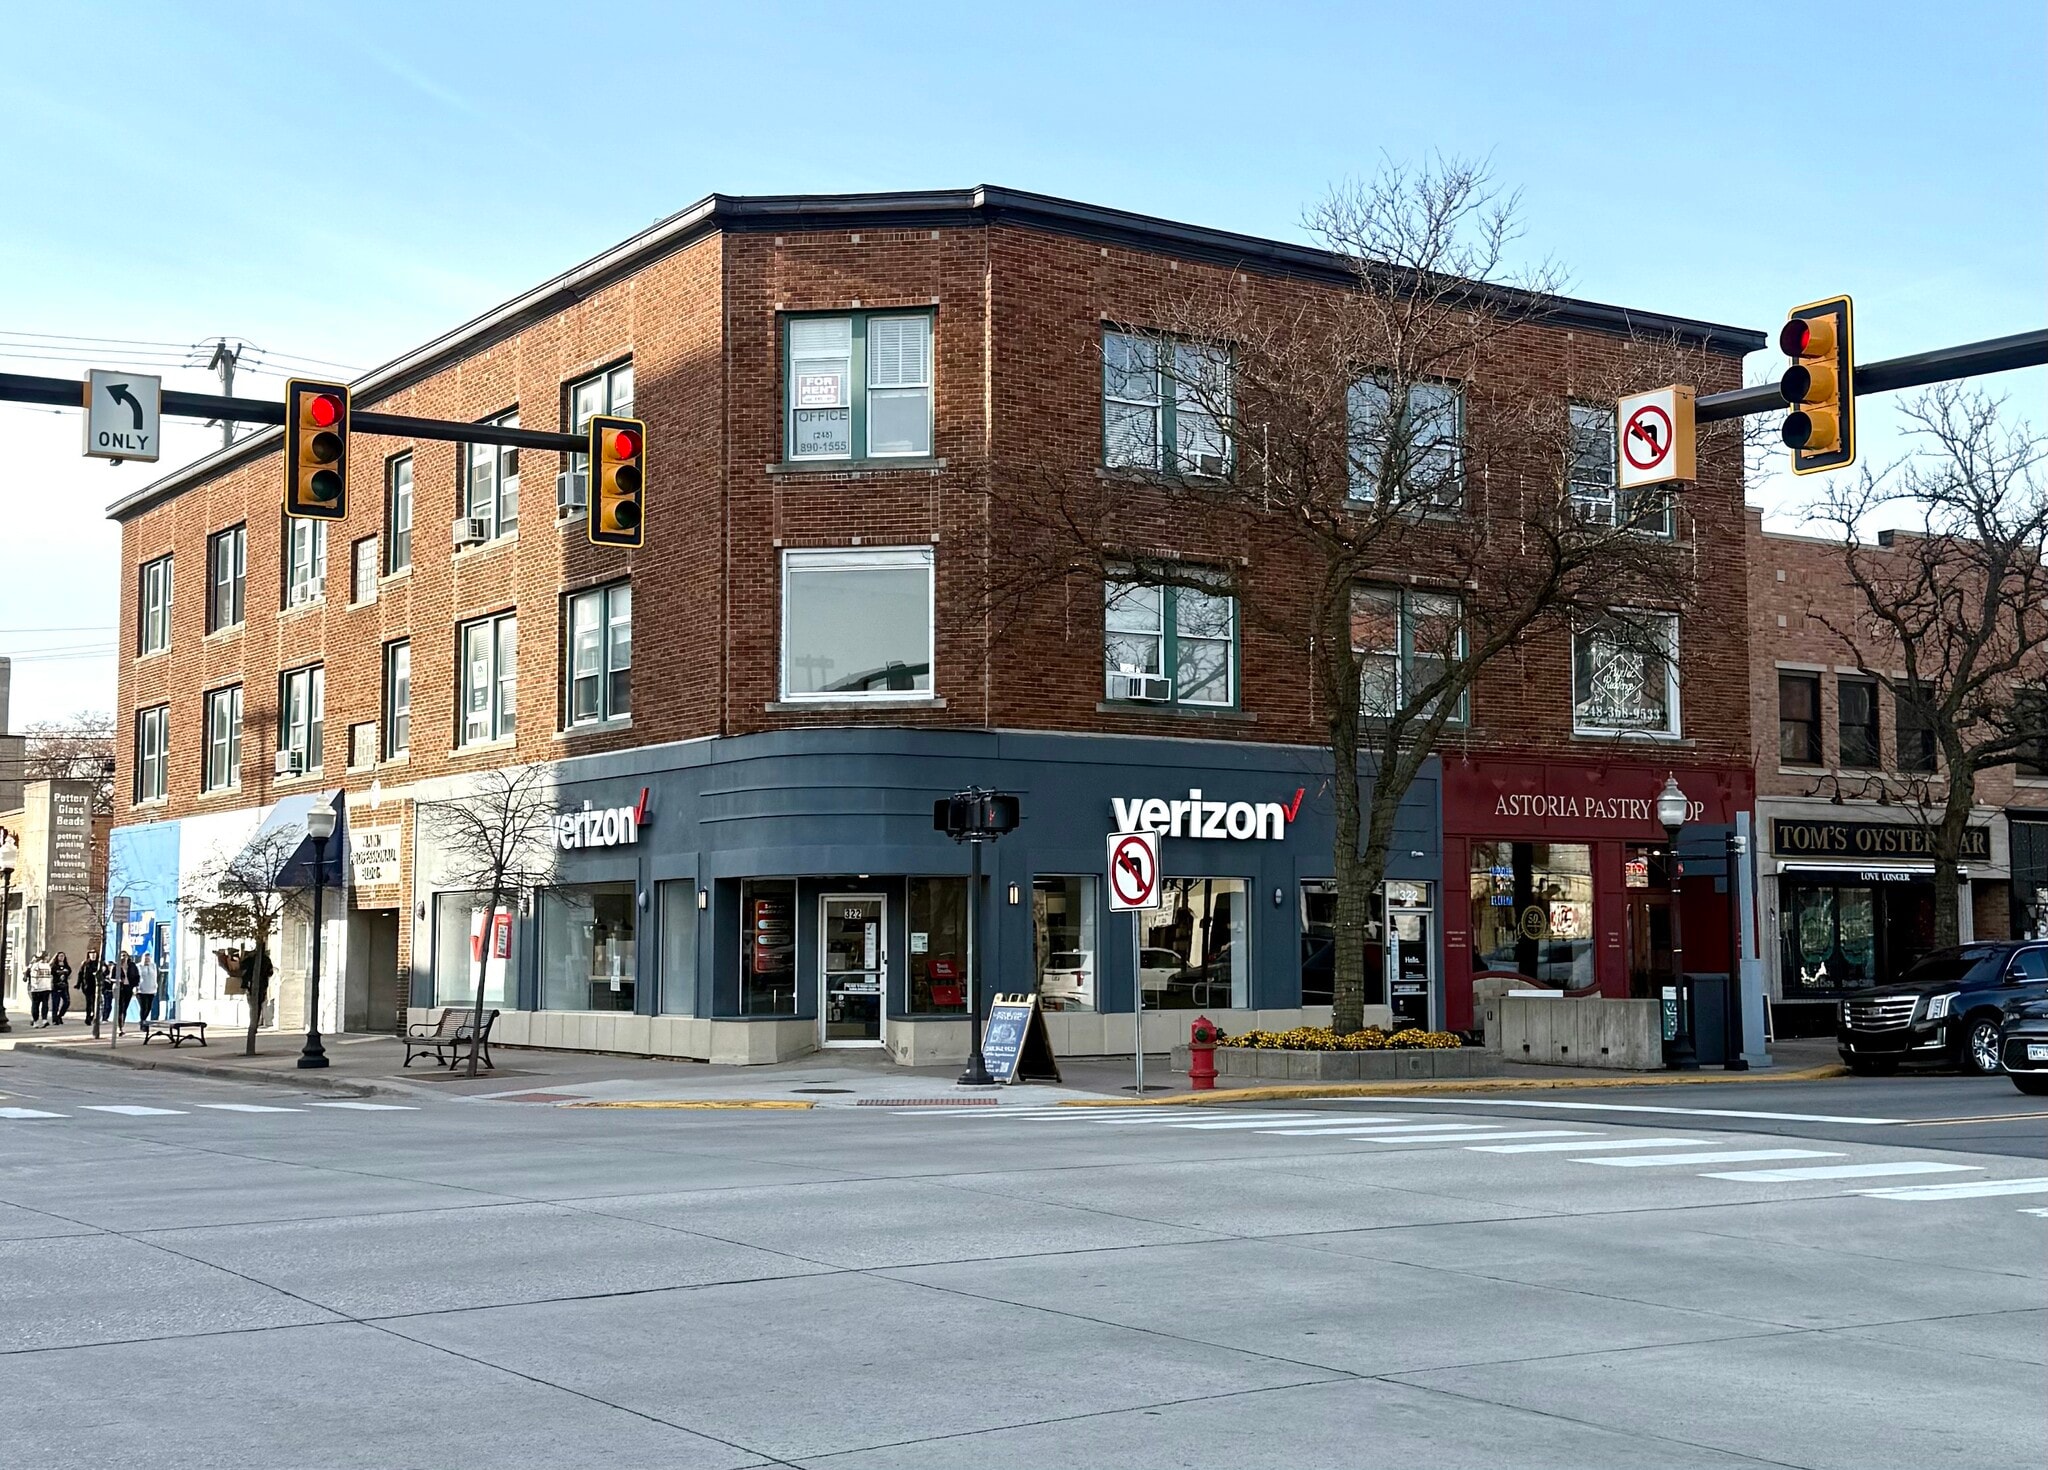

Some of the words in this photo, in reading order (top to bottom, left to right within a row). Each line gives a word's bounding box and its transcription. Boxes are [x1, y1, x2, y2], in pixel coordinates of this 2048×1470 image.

[806, 377, 833, 386] FOR
[801, 386, 837, 395] RENT
[799, 410, 848, 422] OFFICE
[99, 431, 149, 450] ONLY
[800, 441, 848, 453] 890-1555
[53, 793, 89, 805] Pottery
[58, 804, 84, 815] Glass
[1495, 794, 1580, 817] ASTORIA
[1584, 797, 1652, 820] PASTRY
[1111, 788, 1285, 840] verizon
[56, 816, 85, 826] Beads
[548, 800, 638, 850] verizon
[57, 833, 83, 841] pottery
[1779, 825, 1848, 851] TOM'S
[1855, 828, 1937, 853] OYSTER
[1959, 832, 1986, 854] AR
[55, 841, 85, 850] painting
[53, 860, 86, 869] throwing
[1400, 890, 1418, 901] 322
[844, 908, 861, 919] 322
